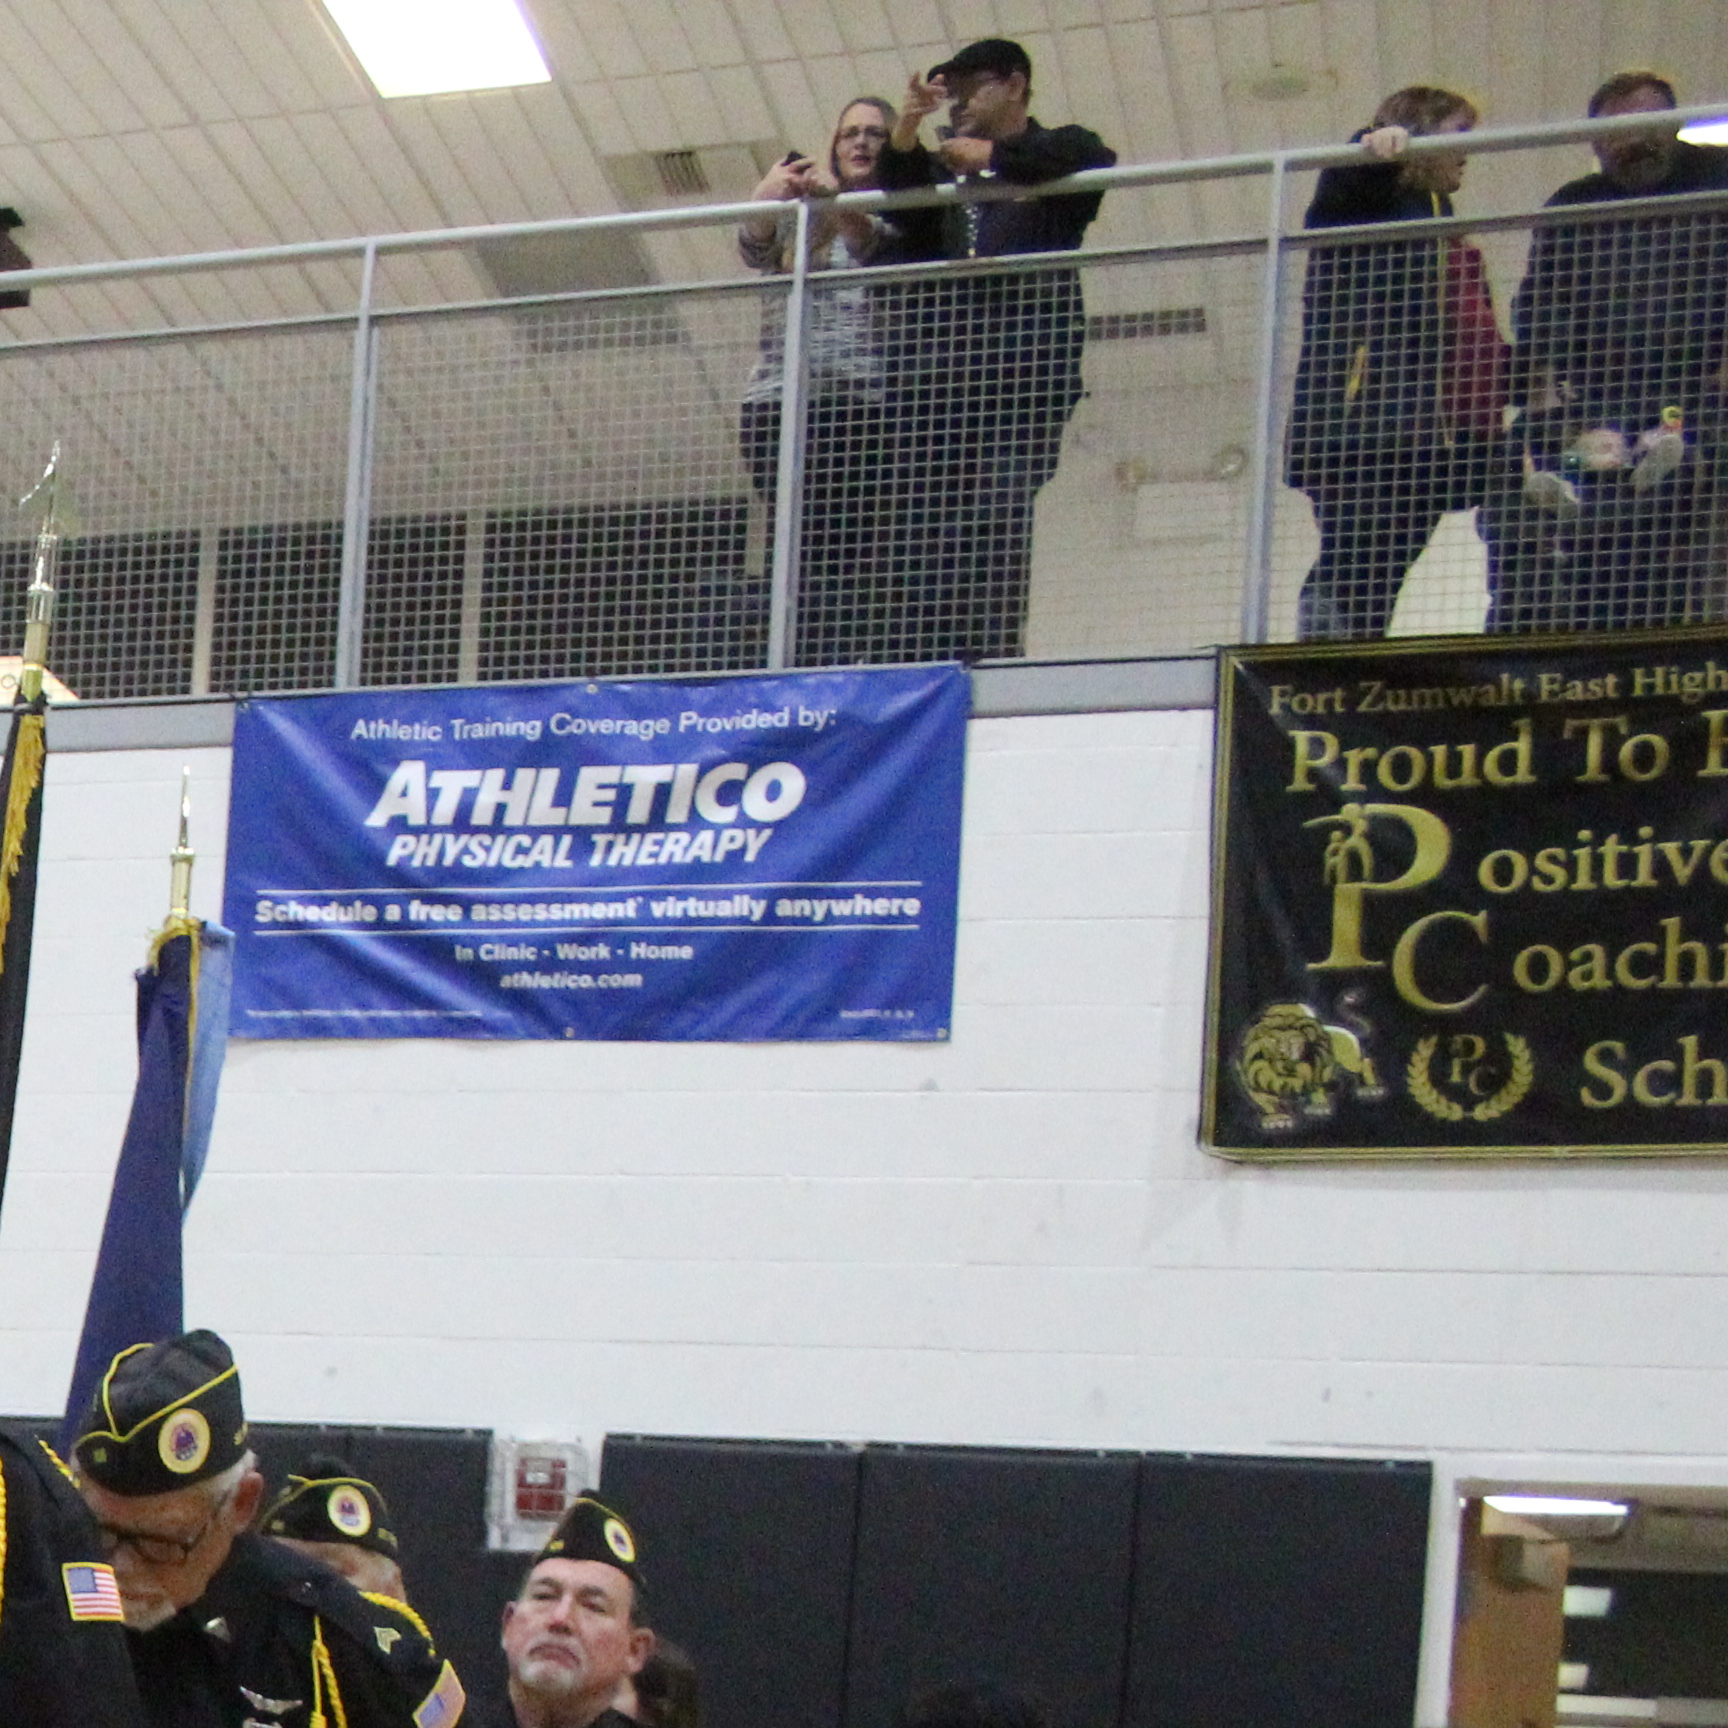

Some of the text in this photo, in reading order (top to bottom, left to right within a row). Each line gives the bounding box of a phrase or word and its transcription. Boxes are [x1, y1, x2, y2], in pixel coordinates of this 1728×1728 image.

[1269, 661, 1728, 717] Fort Zumwalt East High
[350, 705, 837, 741] Athletic Training Coverage Provided by:
[1286, 717, 1536, 792] Proud
[1563, 714, 1670, 783] To
[363, 759, 807, 828] ATHLETICO
[386, 827, 774, 868] PHYSICAL THERAPY
[254, 898, 378, 923] Schedule
[384, 902, 402, 922] a
[408, 898, 463, 922] free
[650, 895, 767, 922] virtually
[774, 893, 922, 923] anywhere
[454, 944, 474, 961] In
[479, 942, 538, 961] Clinic
[555, 942, 611, 961] Work
[630, 942, 694, 960] Home
[500, 970, 643, 989] athletico.com
